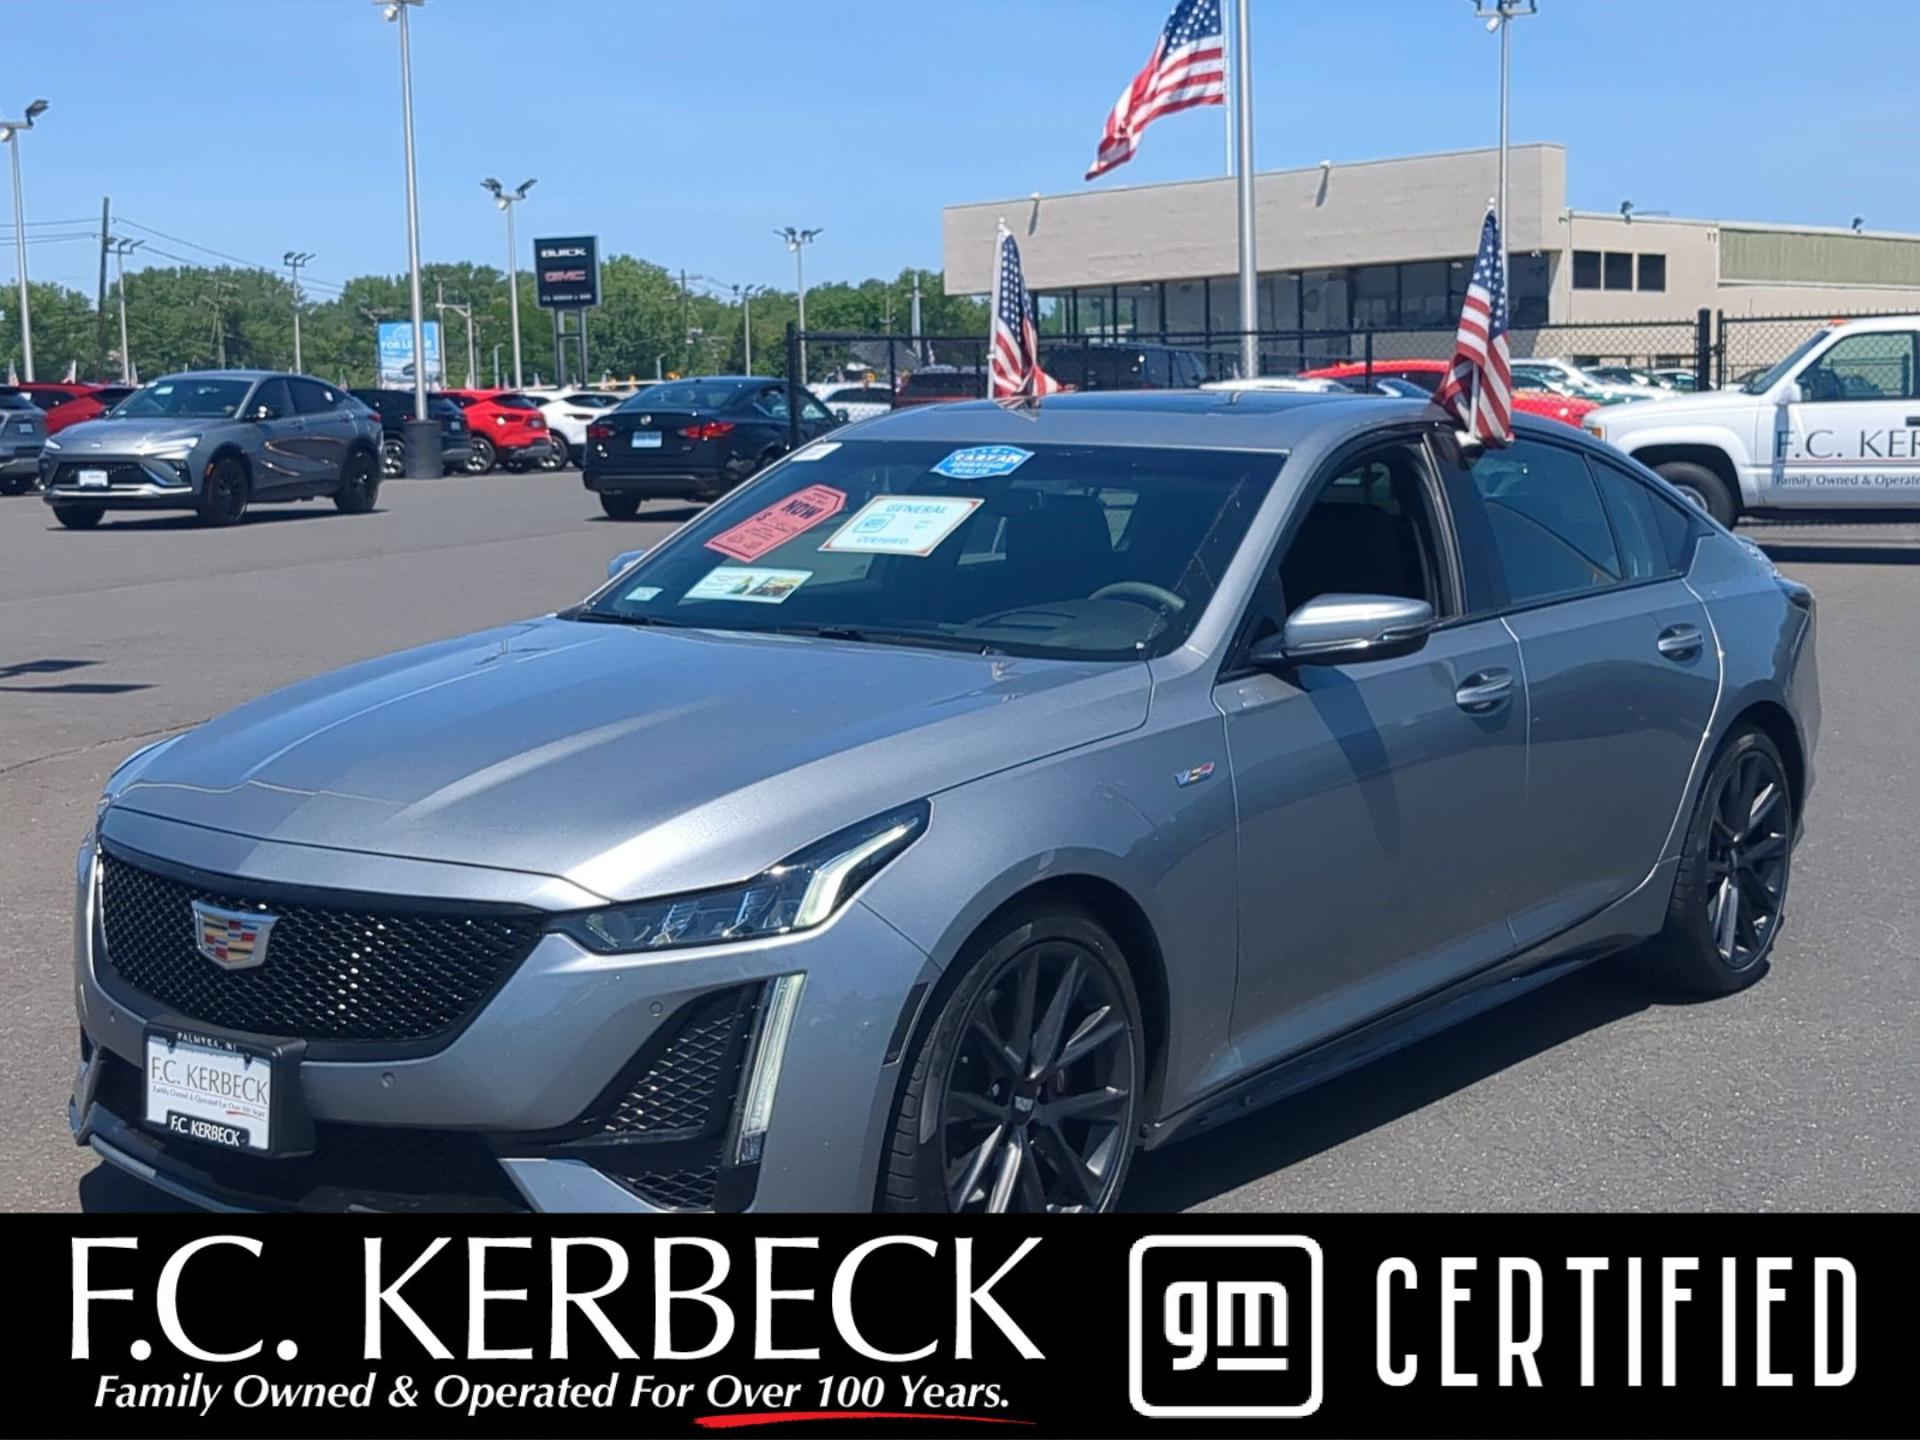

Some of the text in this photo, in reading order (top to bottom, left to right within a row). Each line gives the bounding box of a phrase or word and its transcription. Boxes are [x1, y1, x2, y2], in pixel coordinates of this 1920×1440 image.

[541, 248, 586, 258] BUICK
[544, 270, 586, 282] GMC
[1776, 429, 1843, 459] F.C.
[1776, 474, 1812, 489] Family
[1816, 474, 1858, 486] Owned
[1861, 476, 1871, 486] &
[780, 499, 825, 520] NOW
[886, 504, 948, 514] GENERAL
[152, 1056, 268, 1105] F.C. KERBECK
[190, 1120, 240, 1147] KERBECK
